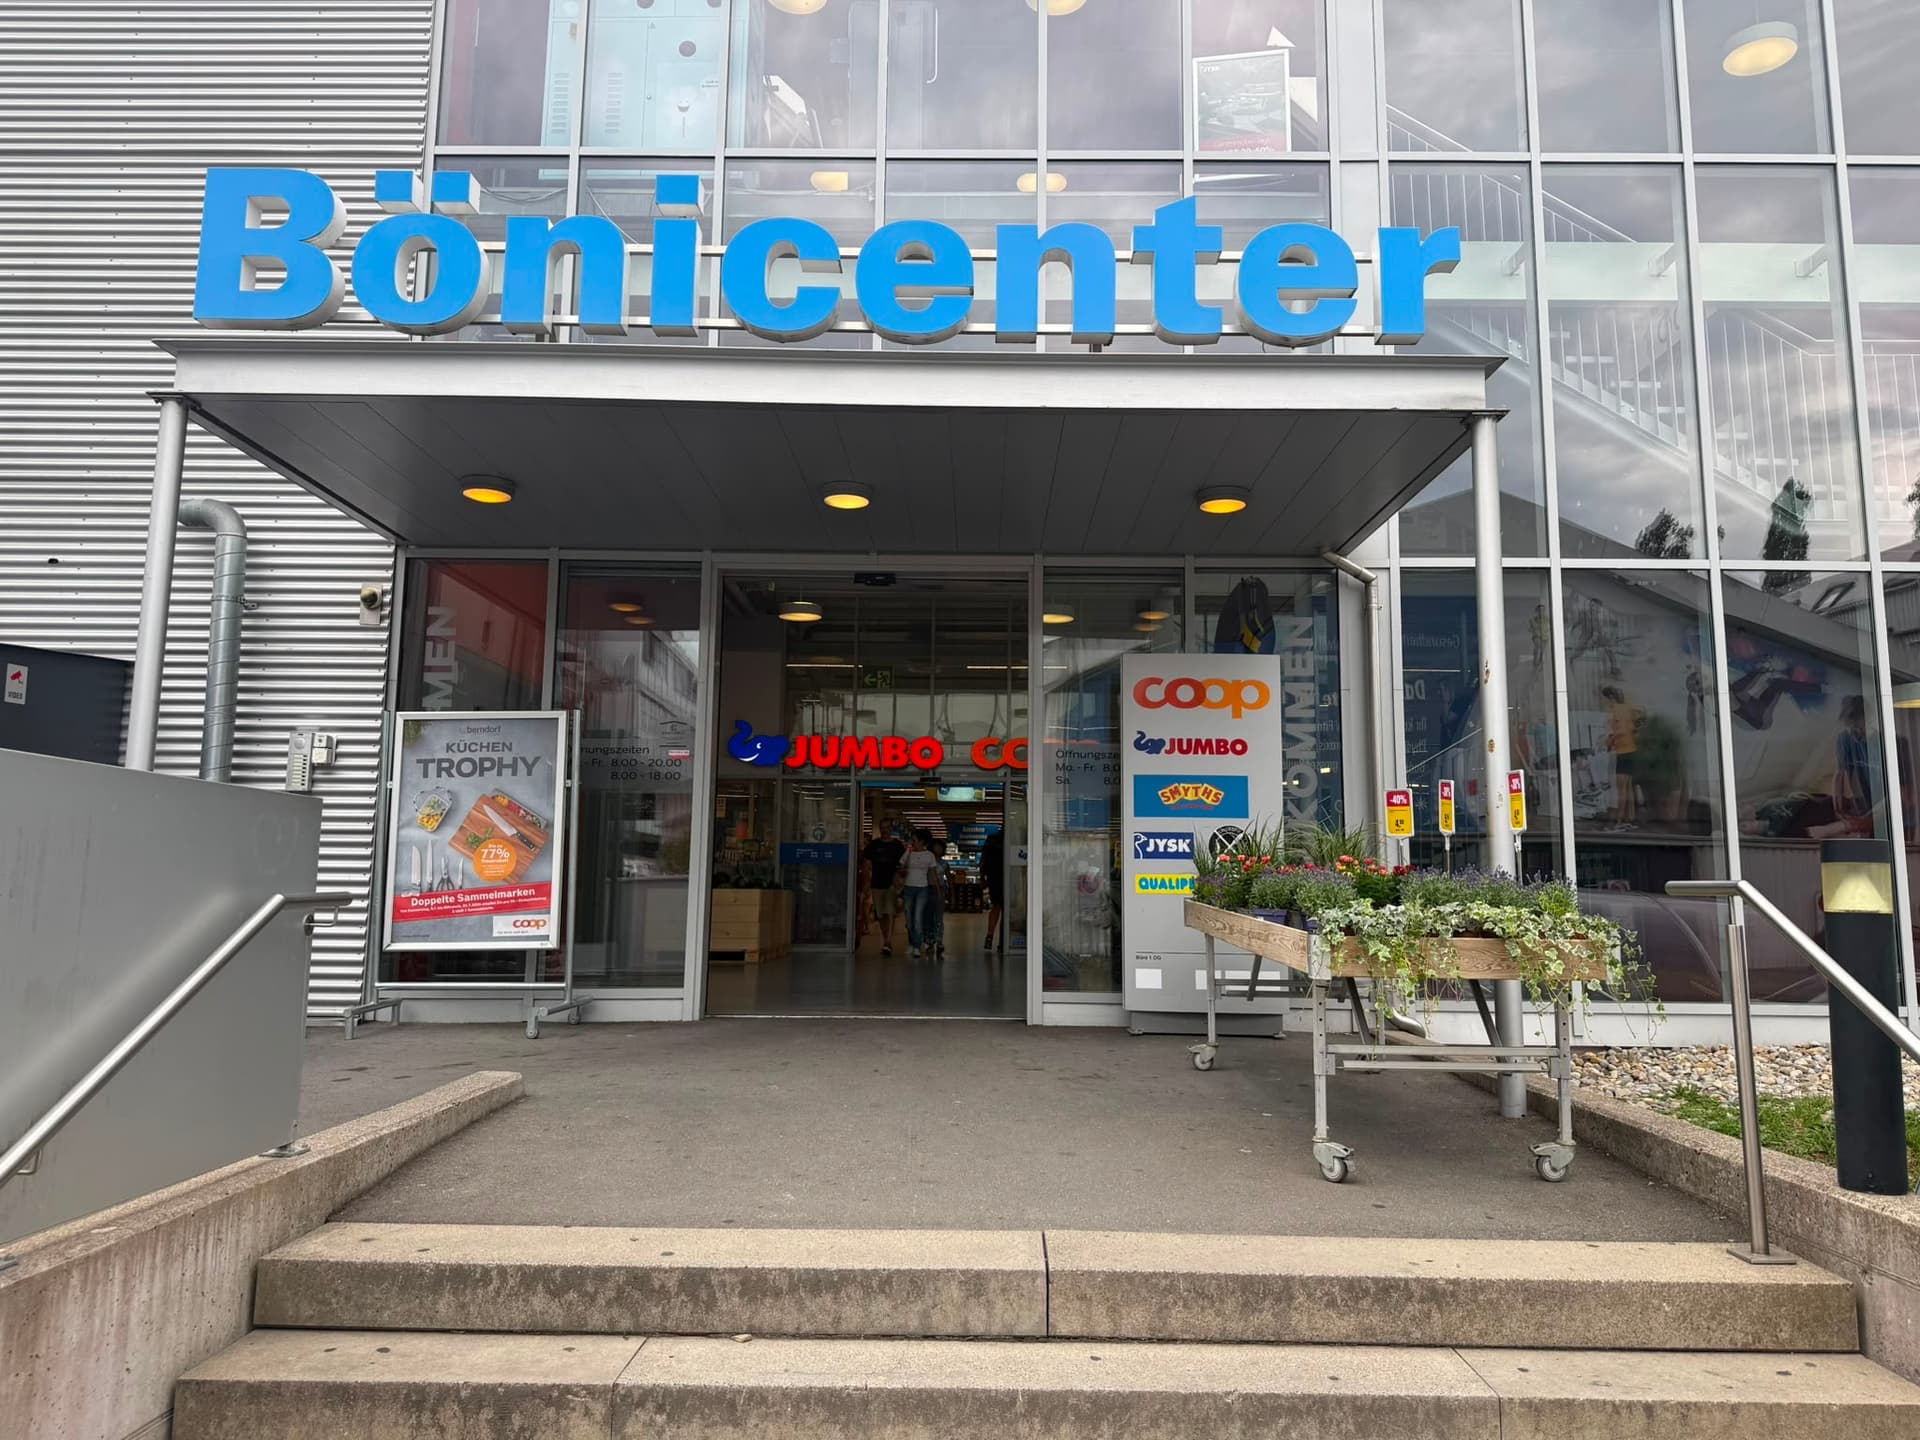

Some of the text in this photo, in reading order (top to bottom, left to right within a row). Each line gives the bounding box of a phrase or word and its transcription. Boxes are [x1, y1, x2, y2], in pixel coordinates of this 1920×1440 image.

[193, 166, 1461, 346] Bönicenter
[422, 606, 458, 709] MEN
[1133, 677, 1270, 720] coop
[466, 725, 501, 735] berndorf
[446, 739, 513, 753] KÜCHEN
[785, 735, 1028, 770] JUMBO co
[1164, 738, 1248, 756] JUMBO
[416, 756, 541, 778] TROPHY
[611, 758, 638, 767] 8.00
[648, 758, 682, 767] 20.00
[1104, 763, 1120, 772] 8.0
[610, 771, 638, 780] 8.00
[648, 771, 681, 780] 18.00
[1104, 776, 1120, 785] 8.0
[1160, 785, 1223, 804] SMYTHS
[1390, 794, 1408, 805] -40%
[1146, 838, 1191, 852] JYSK
[481, 848, 510, 859] 77%
[411, 896, 455, 907] Doppelte
[457, 888, 536, 903] Sammelmarken
[512, 919, 547, 931] coop
